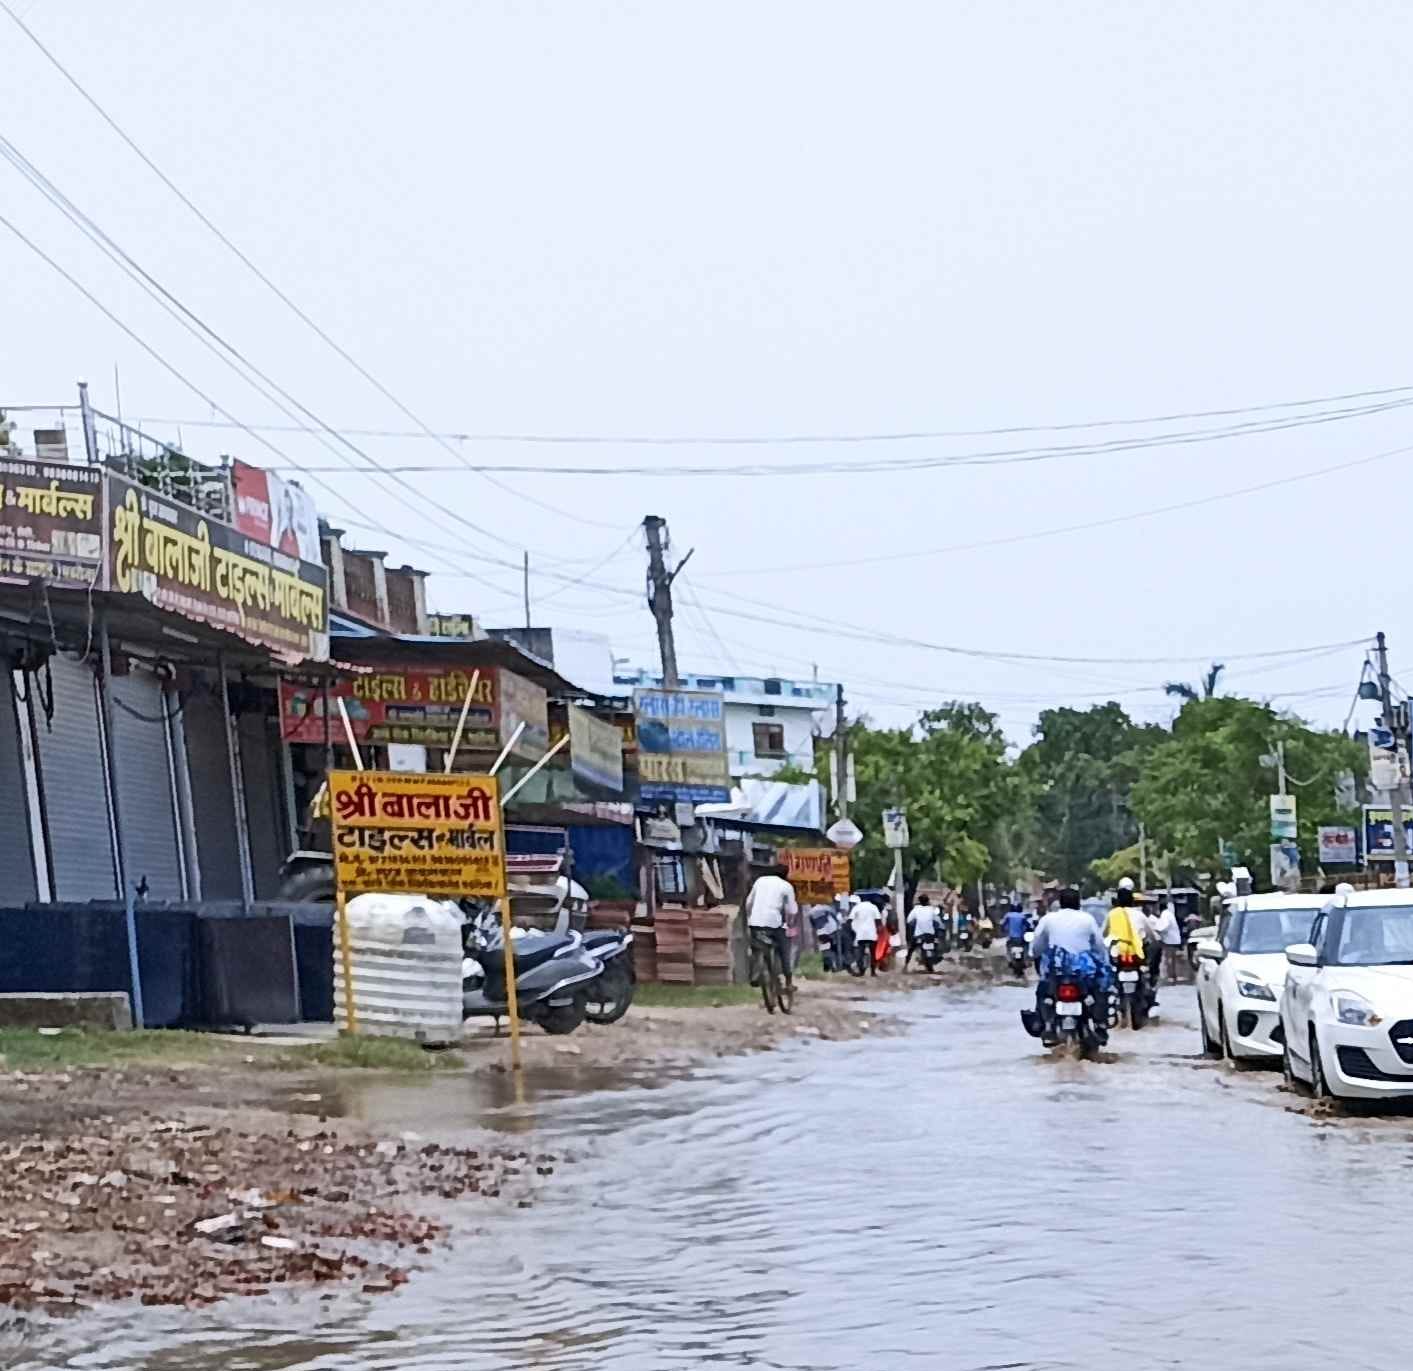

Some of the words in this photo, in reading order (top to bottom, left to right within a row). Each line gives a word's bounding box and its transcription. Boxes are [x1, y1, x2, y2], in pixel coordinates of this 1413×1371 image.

[114, 488, 140, 593] श्री
[336, 784, 378, 820] श्री
[382, 787, 493, 821] बालाजी
[337, 825, 436, 853] टाइल्स
